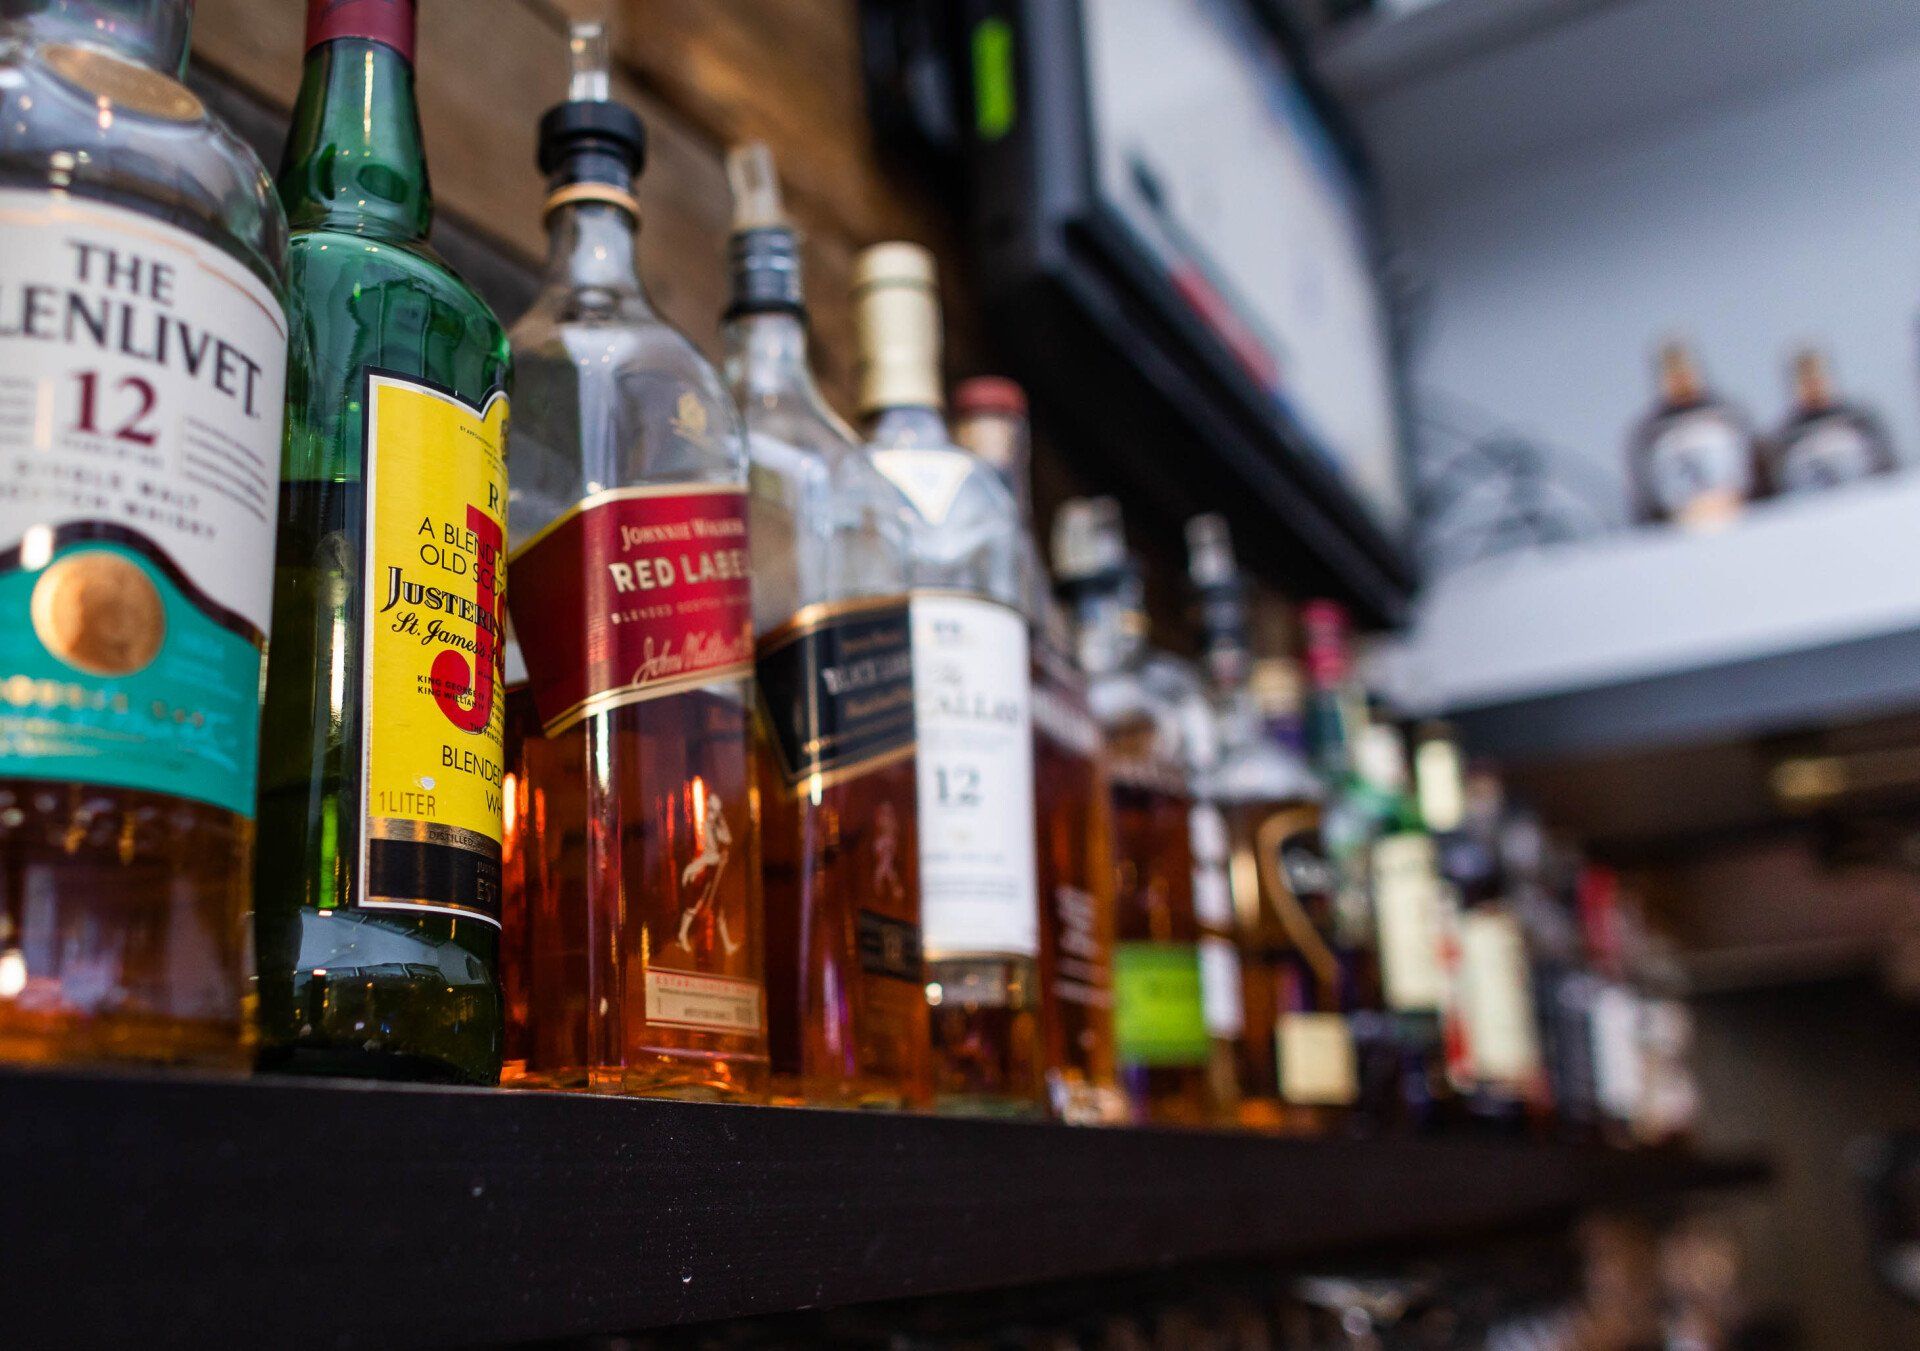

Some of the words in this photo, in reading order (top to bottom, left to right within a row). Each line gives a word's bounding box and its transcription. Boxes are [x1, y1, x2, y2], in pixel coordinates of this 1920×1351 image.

[70, 239, 176, 306] THE
[70, 370, 157, 447] 12
[418, 516, 436, 539] A
[444, 522, 495, 566] BLEND
[420, 543, 467, 576] OLD
[608, 556, 676, 594] RED
[391, 612, 421, 636] St.
[417, 675, 442, 686] KING
[445, 681, 476, 696] GEORGE
[417, 686, 442, 698] KING
[934, 763, 984, 808] 12
